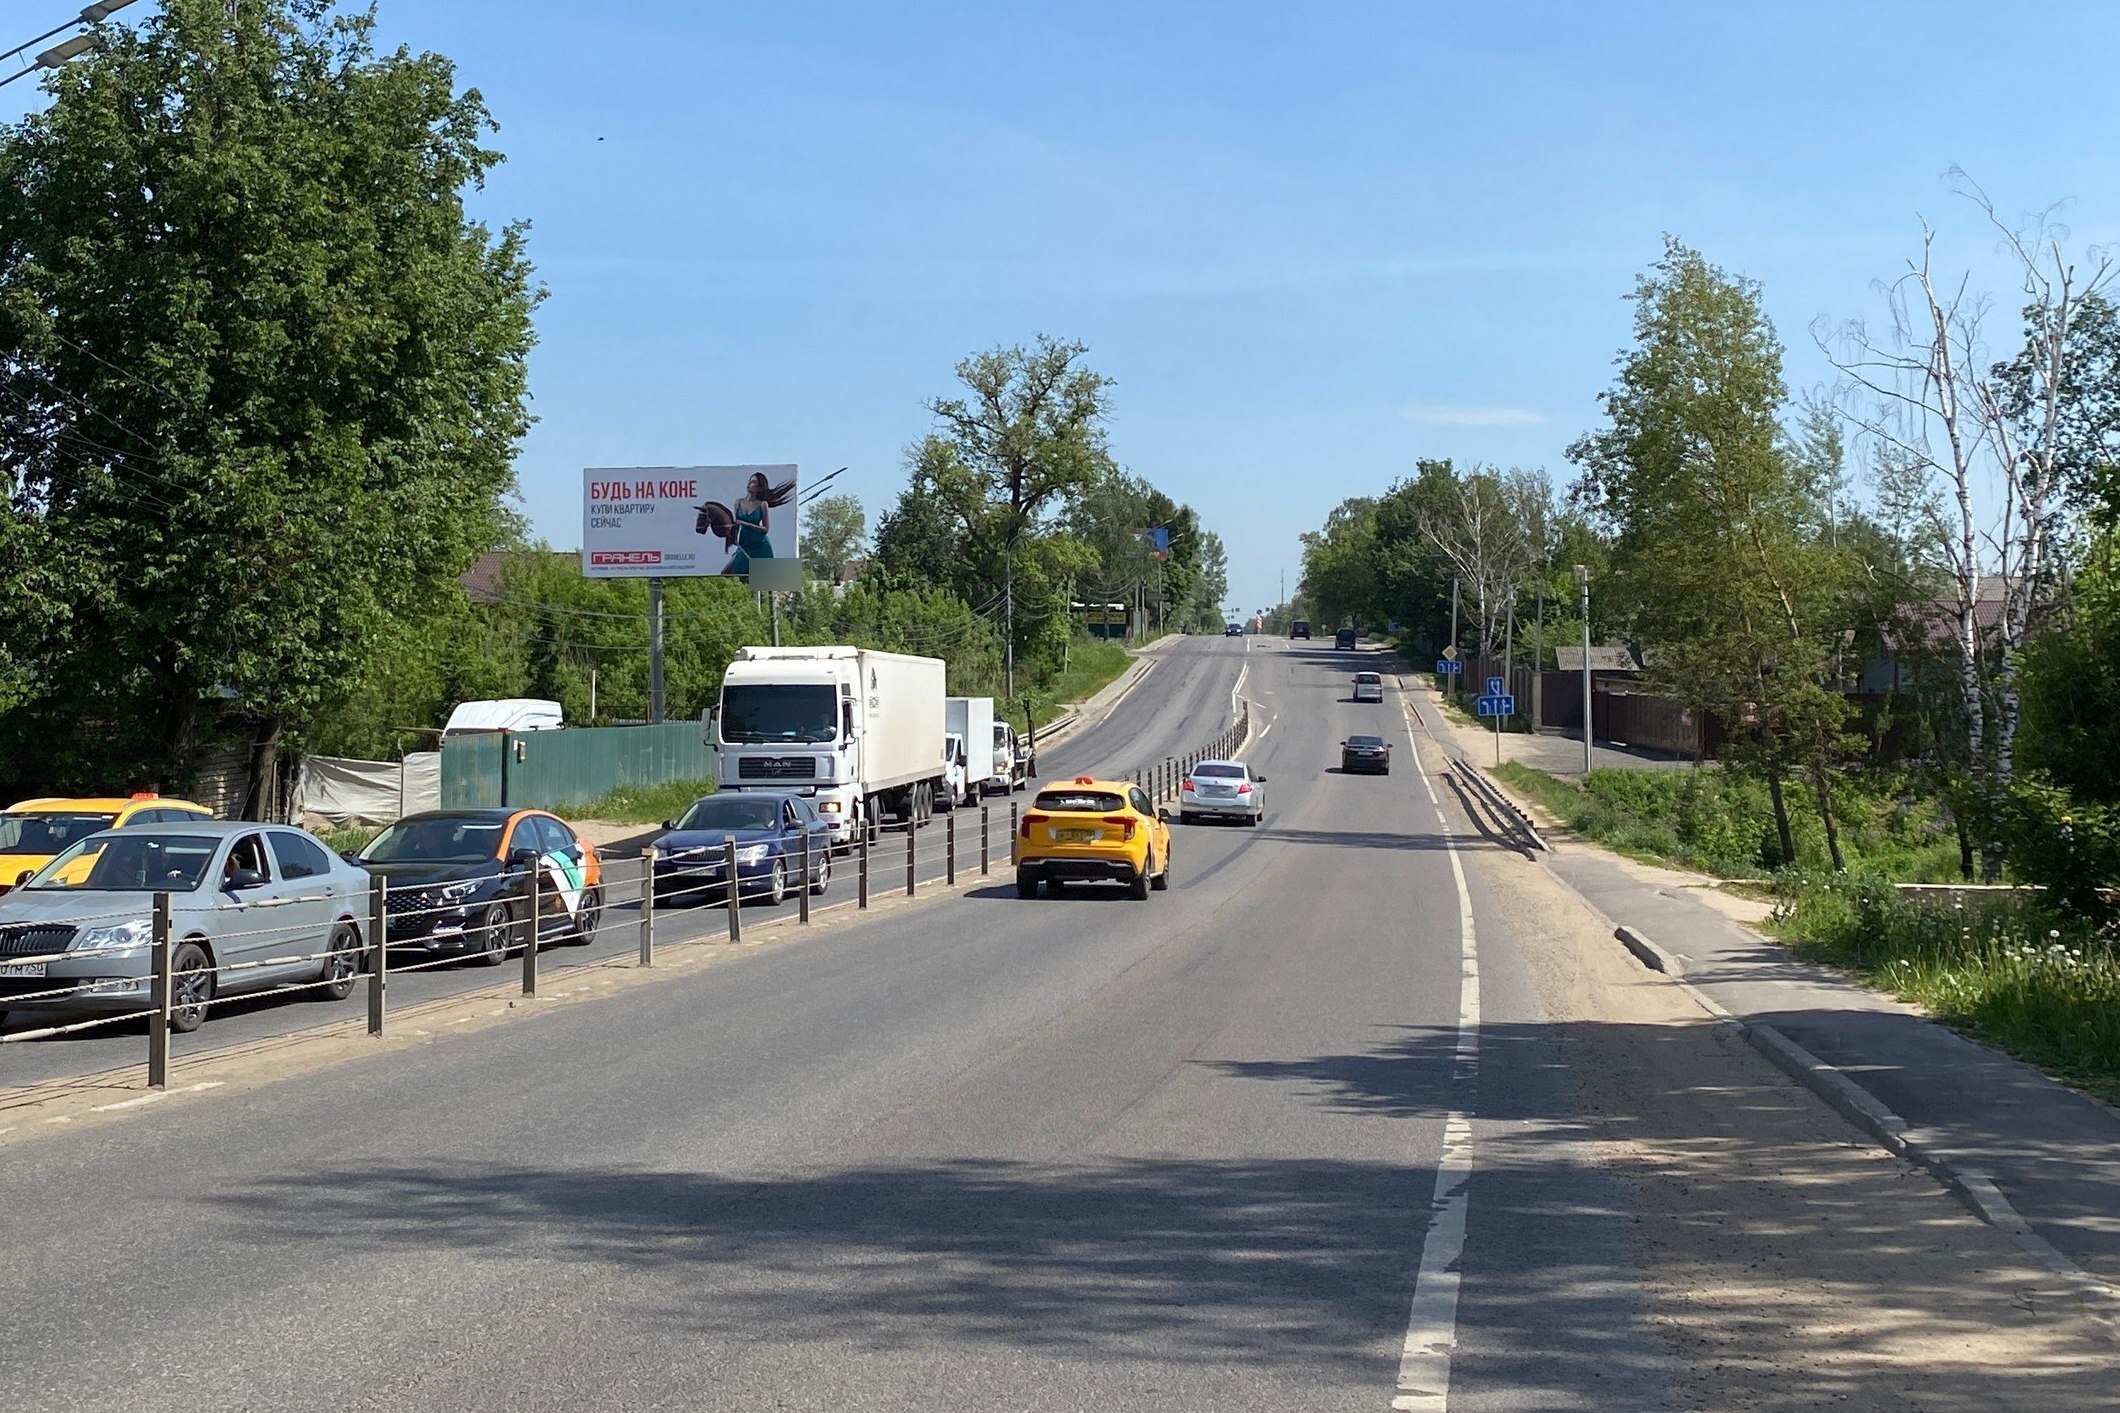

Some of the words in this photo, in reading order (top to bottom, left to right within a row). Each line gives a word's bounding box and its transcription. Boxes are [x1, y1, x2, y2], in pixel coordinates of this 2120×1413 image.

[591, 482, 631, 501] БУДЬ
[635, 481, 655, 499] НА
[659, 480, 698, 498] КОНЕ
[591, 504, 613, 515] КУПИ
[614, 503, 655, 514] КВАРТИРУ
[591, 516, 622, 528] СЕЙЧАС
[592, 552, 660, 563] ГРАНЕЛЬ
